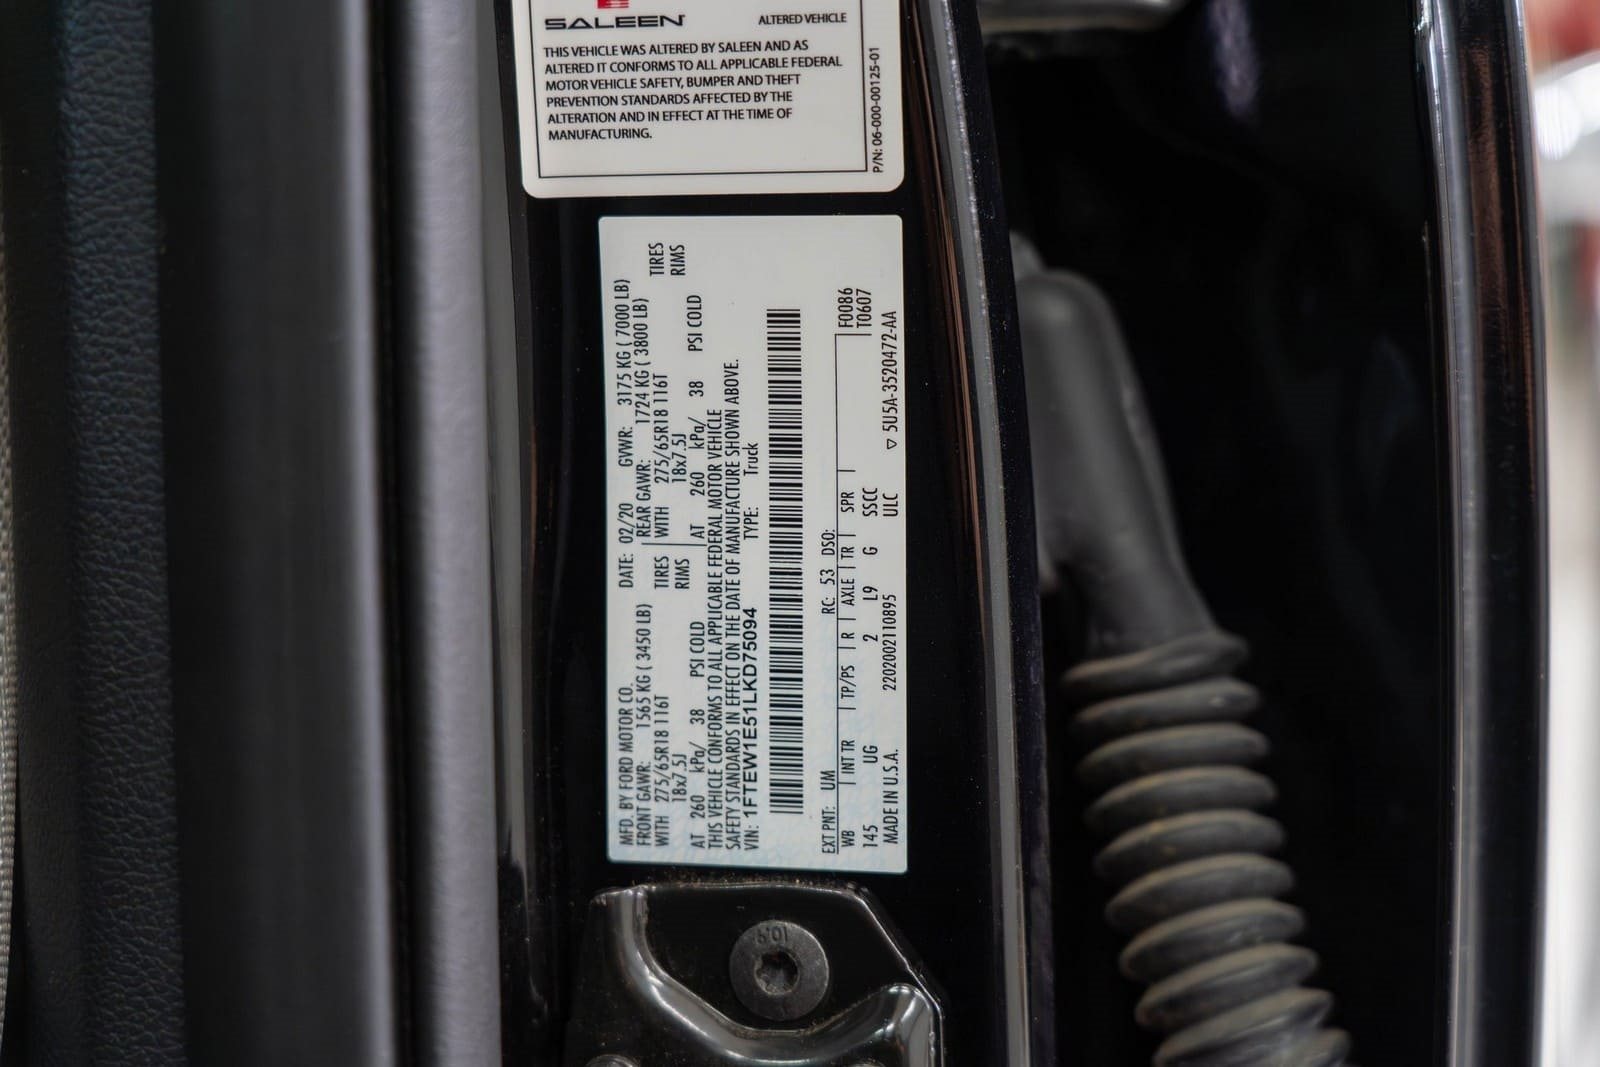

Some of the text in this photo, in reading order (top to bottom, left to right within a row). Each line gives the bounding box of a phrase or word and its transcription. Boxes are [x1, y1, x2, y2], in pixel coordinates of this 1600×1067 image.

[544, 14, 686, 30] SALEEN
[758, 12, 847, 25] ALTERED VEHICLE
[543, 39, 809, 58] THIS VEHICLE WAS ALTERED BY SALEEN AND AS
[545, 56, 842, 74] ALTERED IT CONFORMS TO ALL APPLICABLE FEDERAL
[546, 74, 801, 91] MOTOR VEHICLE SAFETY, BUMPER AND THEFT
[546, 91, 792, 108] PREVENTION STANDARDS AFFECTED BY THE
[869, 48, 883, 173] P/N: 06-000-00125-01
[547, 108, 792, 124] ALTERATION AND IN EFFECT AT THE TIME OF
[548, 128, 652, 141] MANUFACTURING.
[648, 242, 665, 277] TIRES
[669, 244, 686, 276] RIMS
[613, 279, 631, 299] LB)
[632, 298, 649, 318] LB)
[837, 287, 854, 328] F0086
[856, 288, 872, 329] T0607
[616, 351, 631, 368] KG
[881, 311, 898, 432] 5U5A-3520472-AA
[616, 373, 632, 406] 3175
[634, 370, 650, 387] KG
[634, 393, 650, 424] 1724
[686, 295, 707, 539] AT 260 kPa/ 38 PSI COLD
[618, 427, 633, 467] GVWR:
[652, 373, 671, 538] WITH 275/65R18 116T
[671, 433, 687, 483] 18x7.5J
[635, 459, 651, 501] GAWR:
[741, 443, 759, 540] TYPE: Truck
[840, 492, 855, 513] SPR
[862, 487, 878, 517] SSCC
[882, 493, 899, 517] ULC
[633, 506, 651, 537] REAR
[617, 503, 636, 588] DATE: 02/20
[840, 546, 855, 560] TR
[862, 546, 878, 555] G
[654, 556, 669, 589] TIRES
[674, 558, 690, 589] RIMS
[819, 529, 835, 614] RC: 53 DSO:
[723, 359, 741, 850] SAFETY STANDARDS IN EFFECT ON THE DATE OF MANUFACTURE SHOWN ABOVE.
[840, 578, 855, 606] AXLE
[862, 586, 878, 601] L9
[636, 604, 653, 624] LB)
[706, 409, 723, 849] THIS VEHICLE CONFORMS TO ALL APPLICABLE FEDERAL MOTOR VEHICLE
[862, 634, 878, 642] 2
[882, 594, 897, 691] 2202002110895
[635, 675, 651, 692] KG
[839, 665, 856, 699] TP/PS
[636, 697, 651, 728] 1565
[689, 621, 707, 849] AT 260 kPa/ 38 PSI COLD
[742, 607, 759, 851] VIN: 1FTEW1E51LKD75094
[618, 683, 634, 845] MFD. BY FORD MOTOR CO.
[841, 740, 855, 774] INT TR
[862, 745, 878, 764] UG
[636, 762, 651, 801] GAWR:
[653, 695, 671, 847] WITH 275/65R18 116T
[671, 754, 687, 802] 18x7.5J
[820, 770, 836, 854] EXT PNT: UM
[882, 749, 899, 844] MADE IN U.S.A.
[636, 806, 652, 846] FRONT
[841, 830, 855, 847] WB
[862, 825, 878, 848] 145
